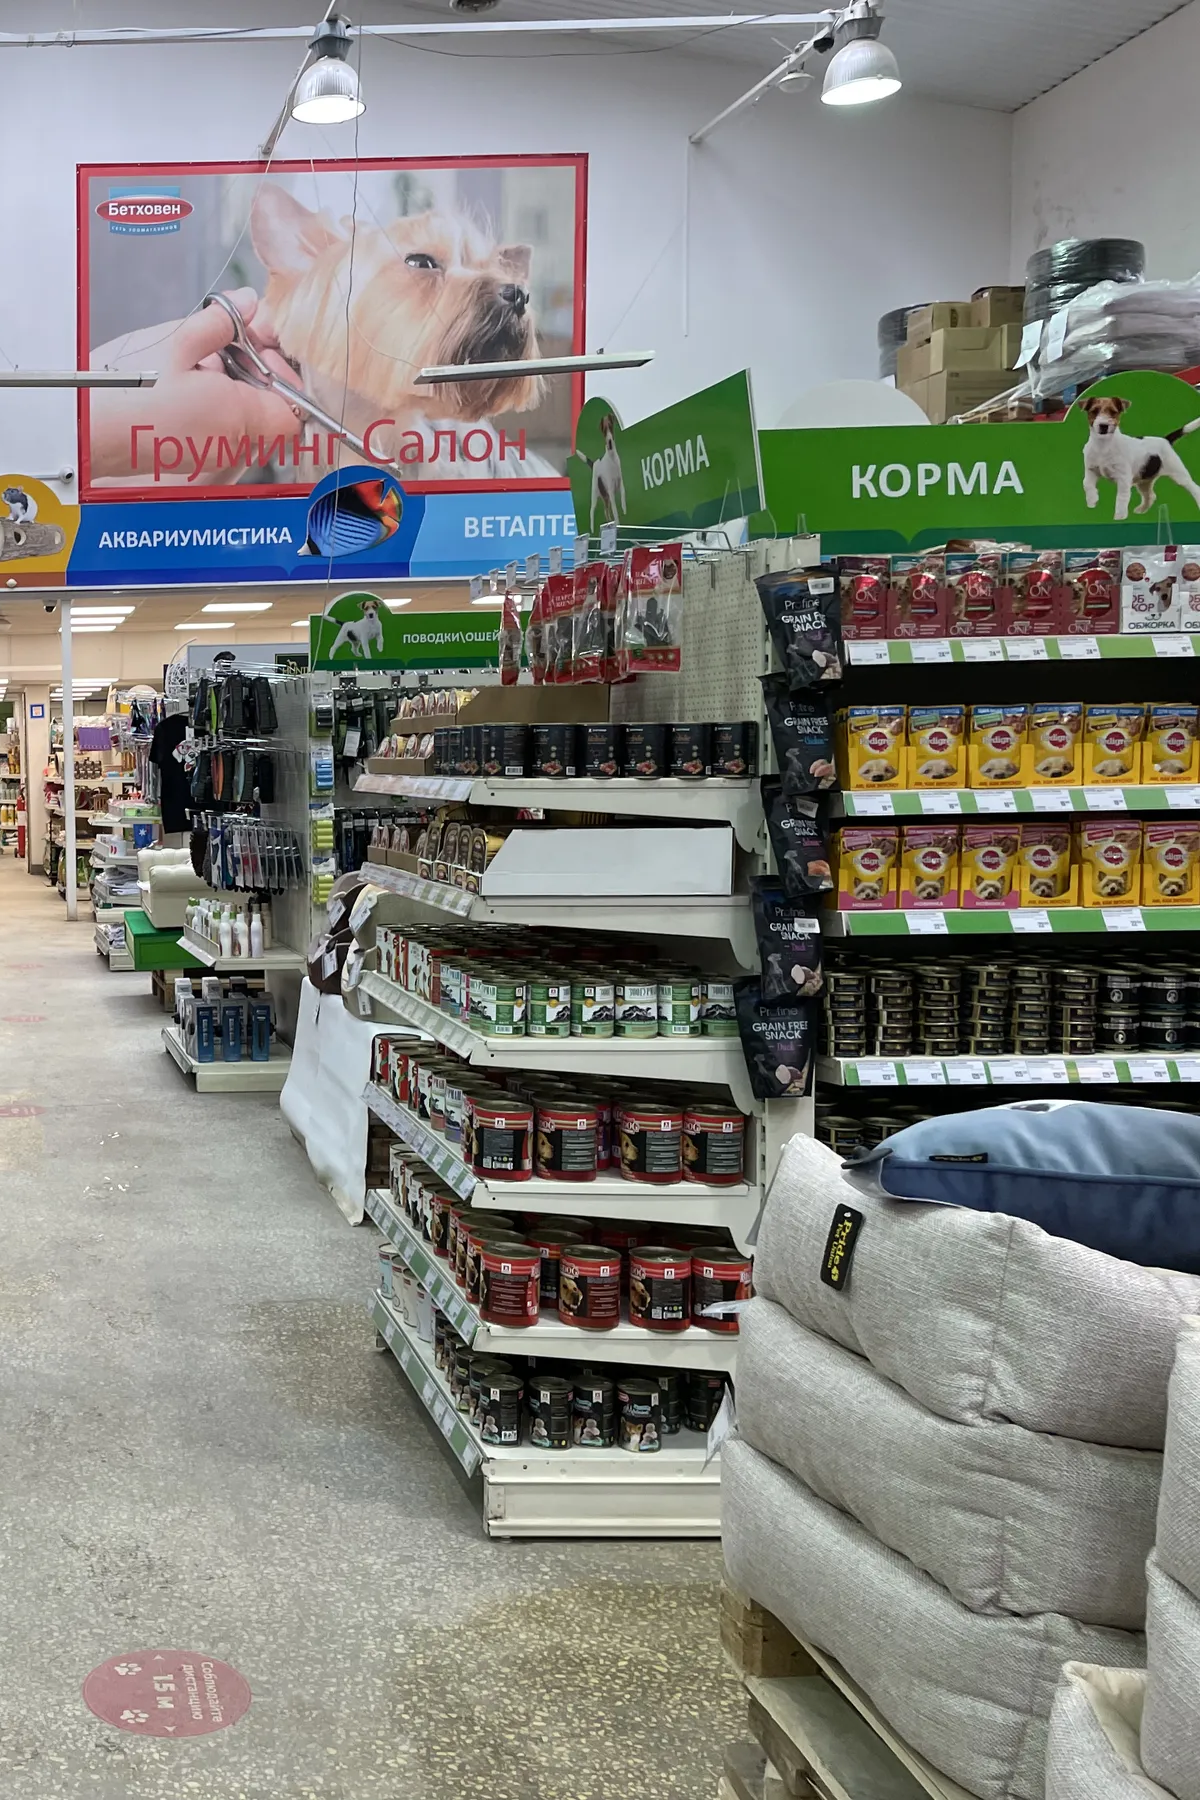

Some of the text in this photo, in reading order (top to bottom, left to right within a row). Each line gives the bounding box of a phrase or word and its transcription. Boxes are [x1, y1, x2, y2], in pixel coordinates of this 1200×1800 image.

[108, 203, 180, 216] Бетховен
[130, 418, 527, 482] Груминг Салон
[640, 433, 711, 491] КОРМА
[851, 460, 1024, 499] КОРМА
[464, 514, 577, 538] ВЕТАПТЕ
[98, 525, 293, 549] АКВАРИУМИСТИКА
[784, 597, 820, 611] Prfine
[781, 613, 812, 625] GRAIN
[793, 619, 828, 633] SNACK
[1128, 620, 1176, 630] ОБЖОРКА
[403, 629, 501, 645] ПОВОДКИ\ОШЕЙ
[841, 626, 857, 639] NE
[784, 716, 829, 727] GRAIN FREE
[796, 725, 824, 735] SNACK
[780, 931, 812, 941] SNACK
[752, 1020, 809, 1033] GRAIN FREE
[764, 1030, 802, 1040] SNACK
[834, 1219, 852, 1265] Pride
[181, 1663, 203, 1720] дистанцию
[201, 1661, 224, 1723] Соблюдайте
